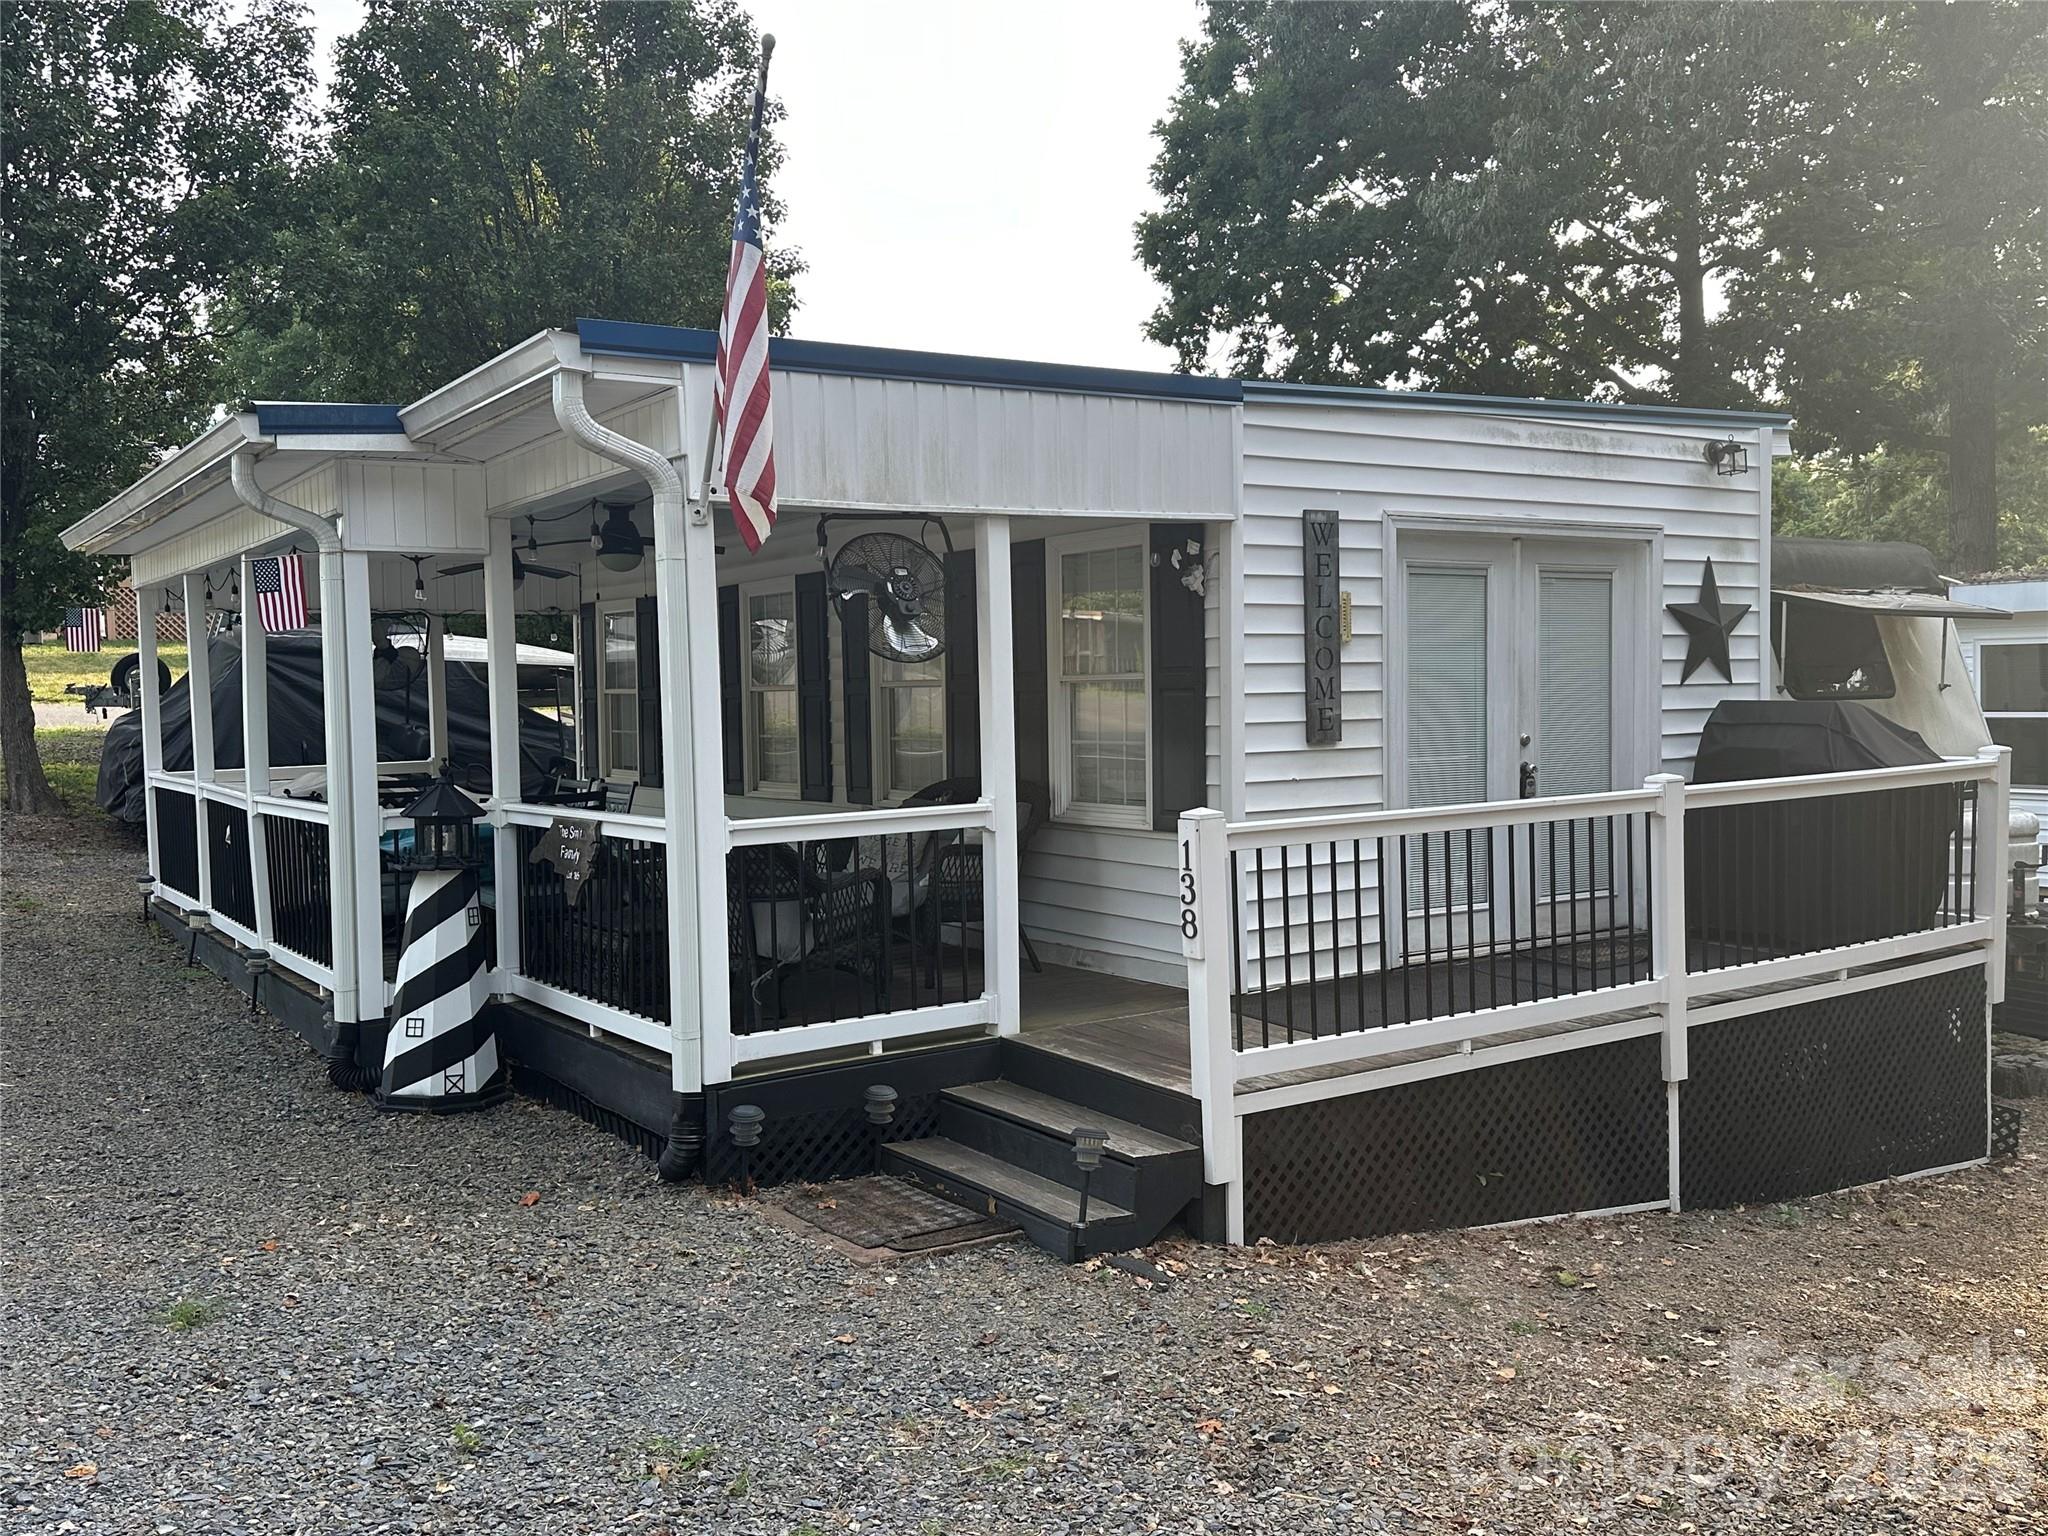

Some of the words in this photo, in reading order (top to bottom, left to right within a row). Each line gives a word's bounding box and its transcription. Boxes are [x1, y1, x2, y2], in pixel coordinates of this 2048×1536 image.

[1310, 522, 1335, 732] WELCOME
[558, 824, 569, 838] The
[1180, 839, 1198, 940] 138
